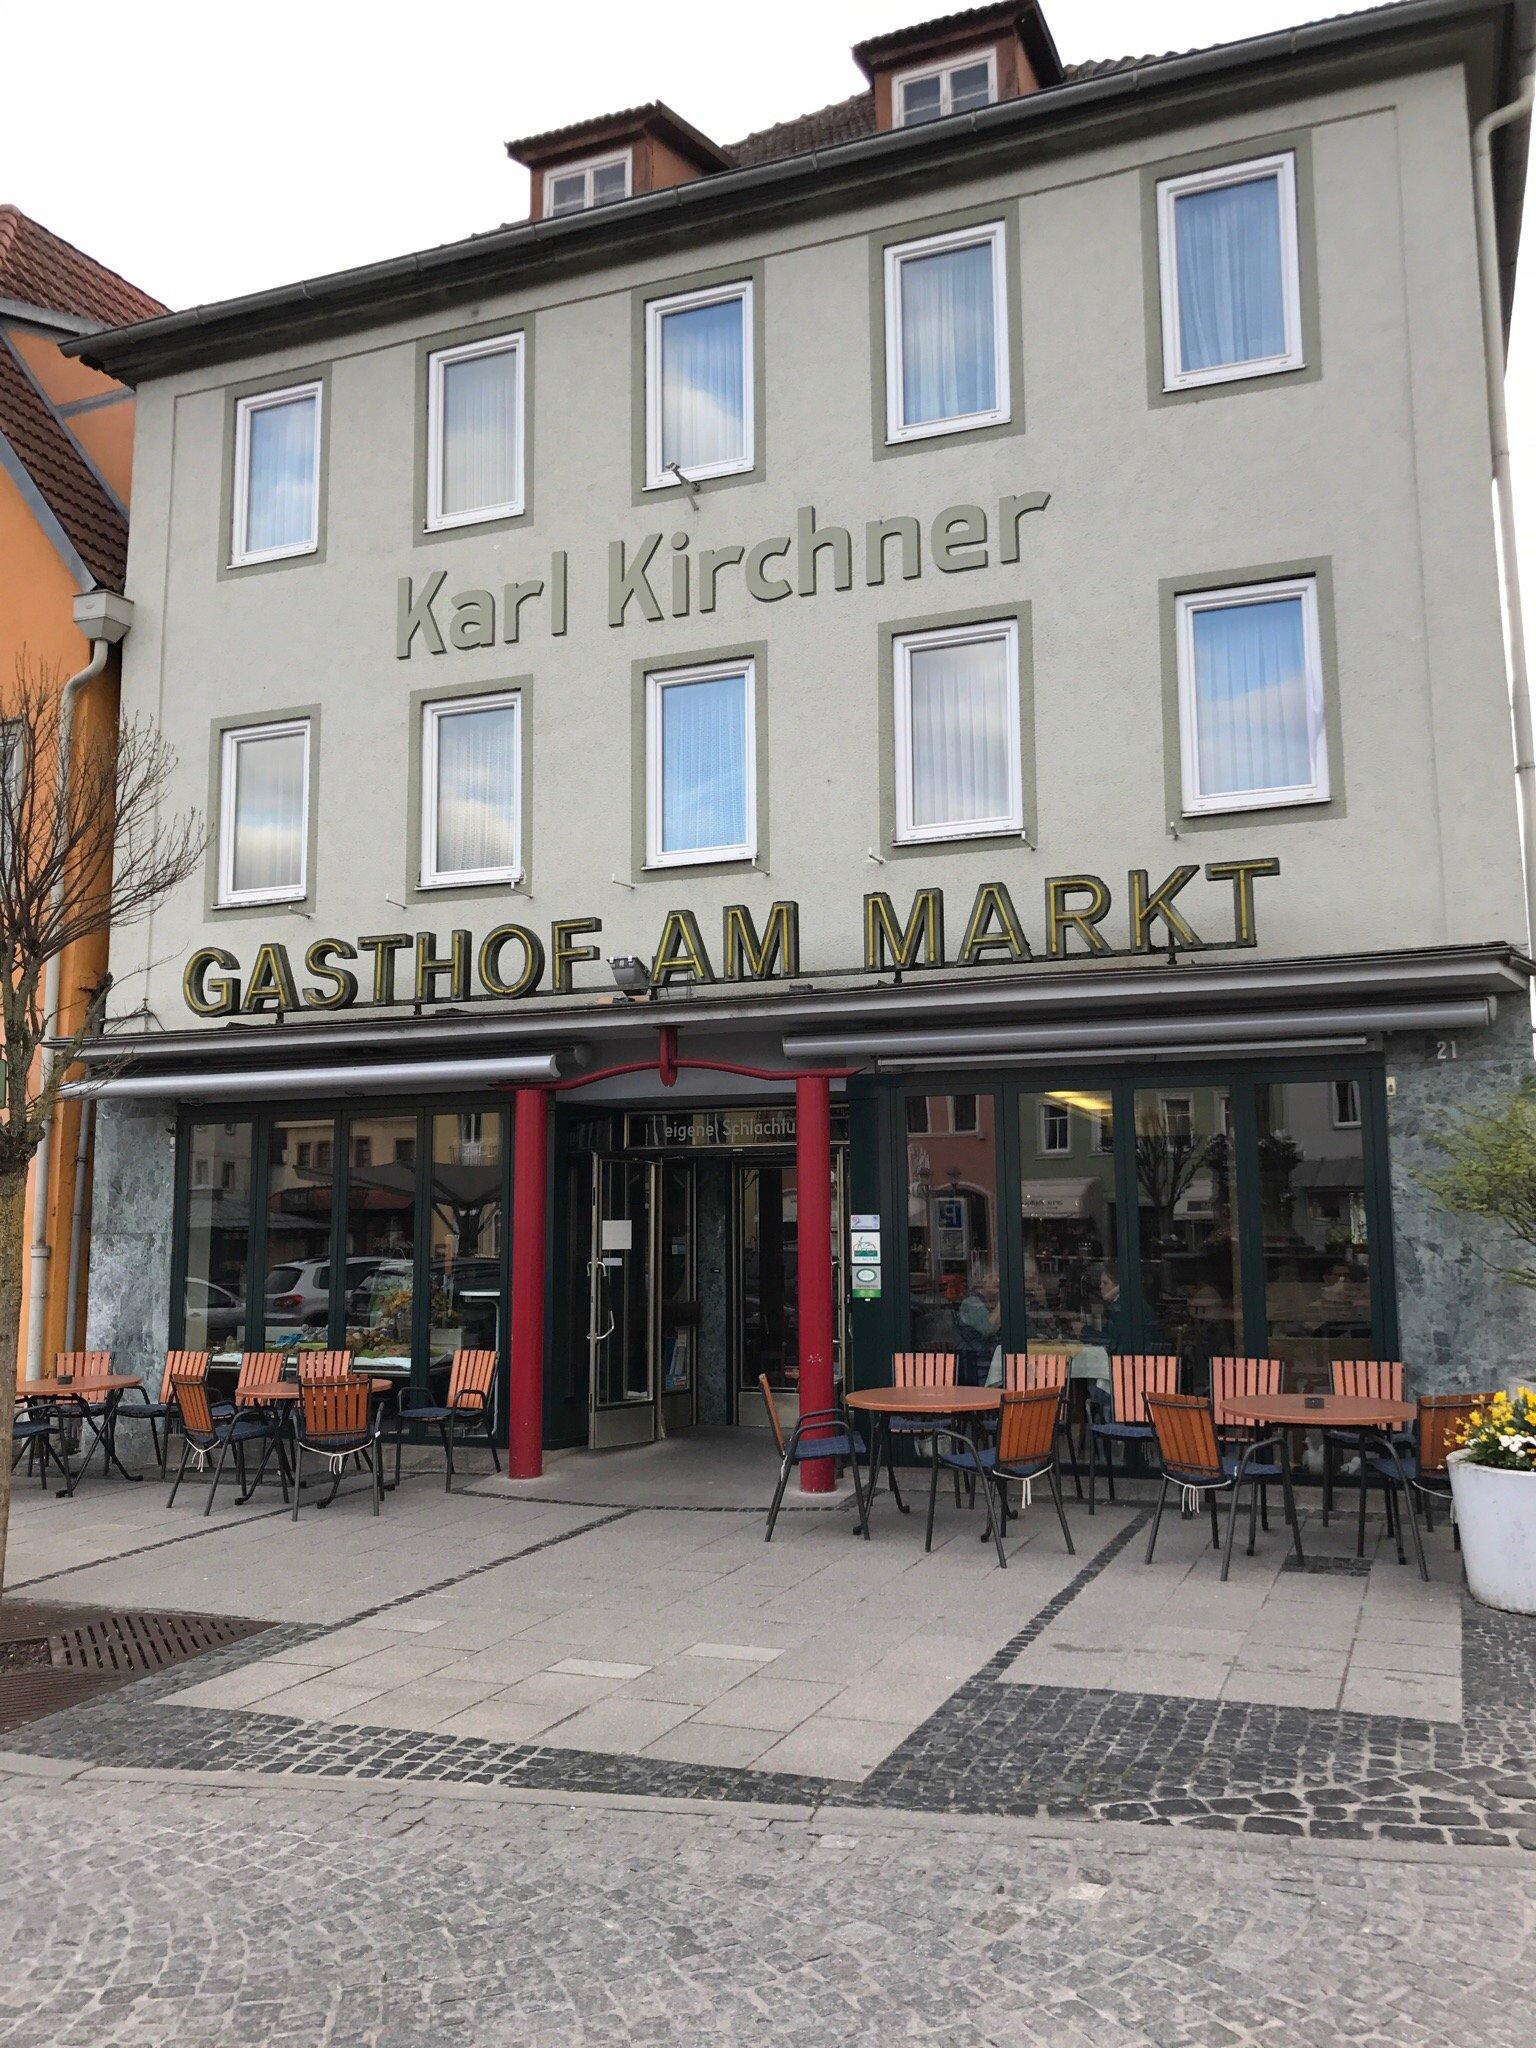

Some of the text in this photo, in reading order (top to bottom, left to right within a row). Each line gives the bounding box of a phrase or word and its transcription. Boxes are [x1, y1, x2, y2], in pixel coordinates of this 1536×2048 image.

[397, 491, 1051, 659] Karl Kirchner
[183, 857, 1280, 1017] GASTHOF AM MARKT
[1437, 1040, 1457, 1059] 21
[664, 1116, 797, 1141] eigene Schlachtu
